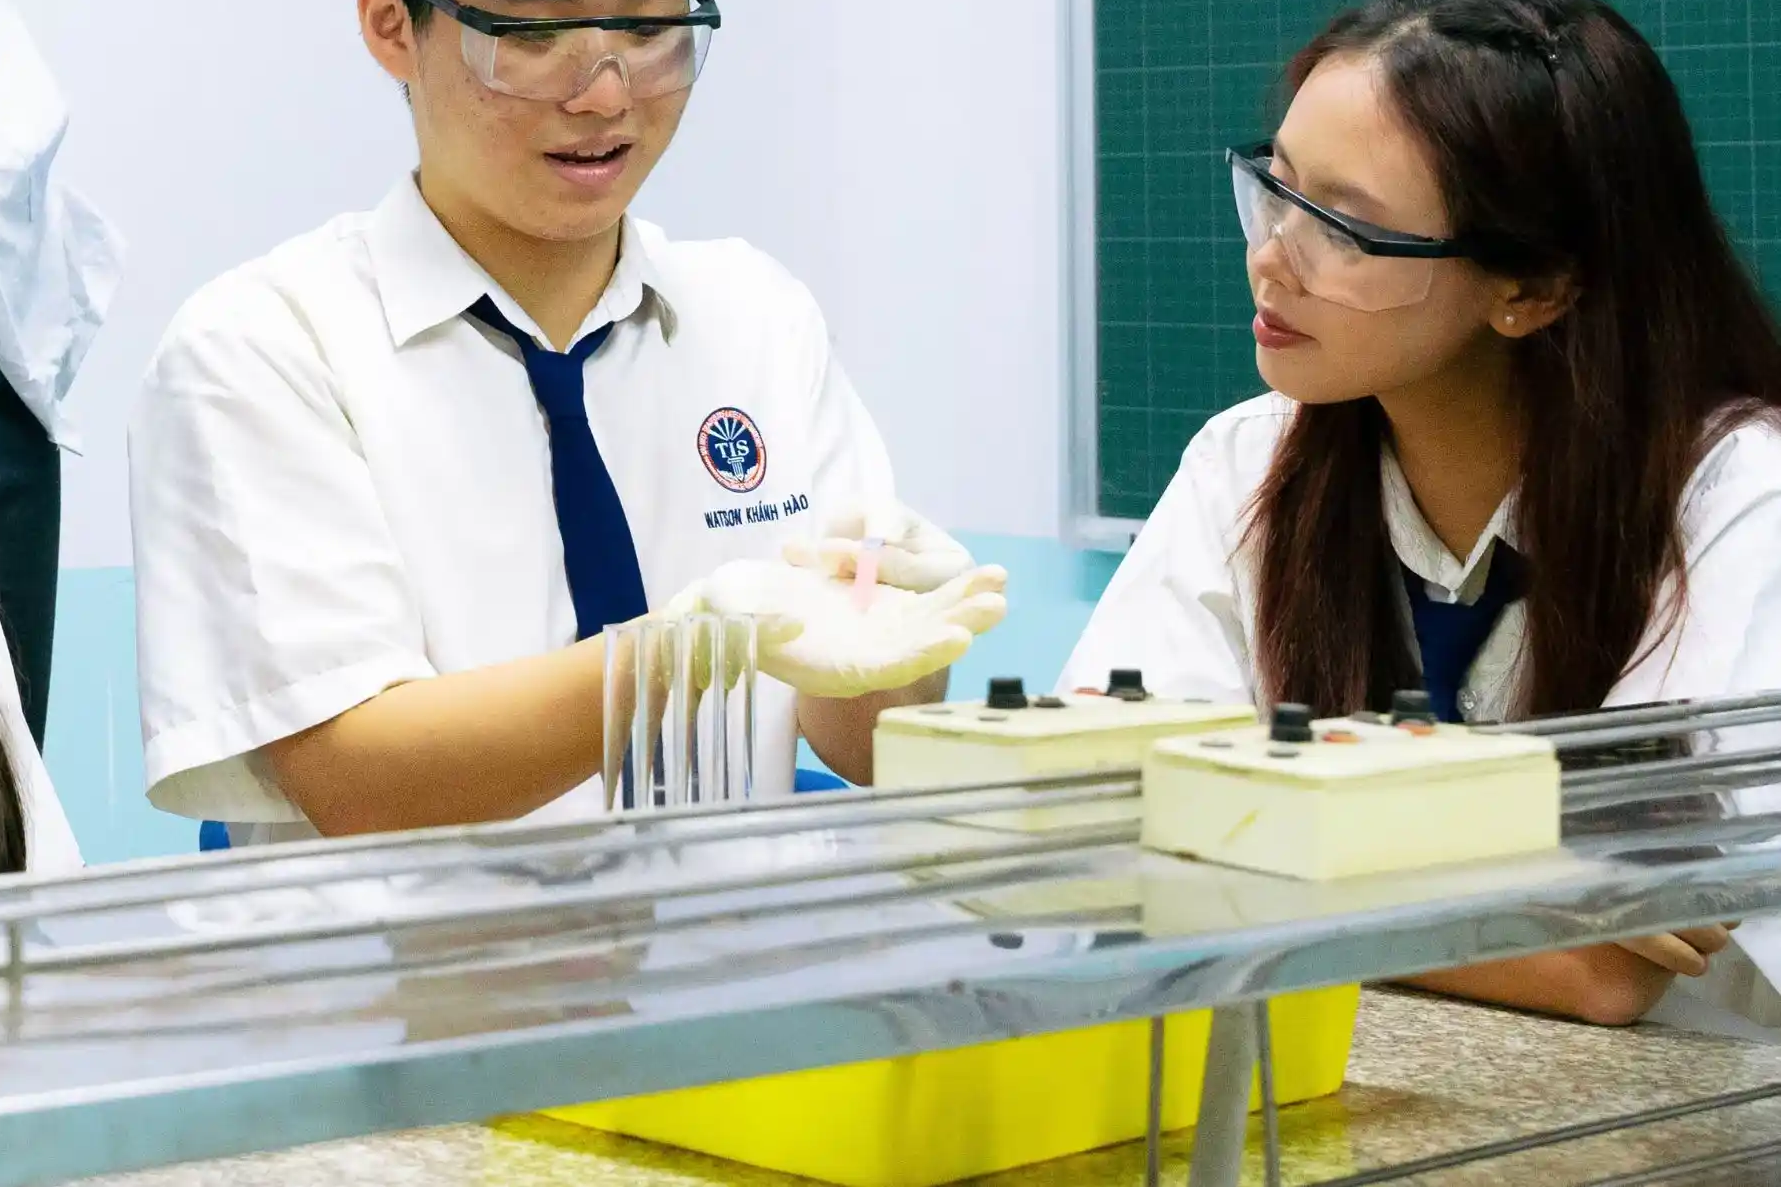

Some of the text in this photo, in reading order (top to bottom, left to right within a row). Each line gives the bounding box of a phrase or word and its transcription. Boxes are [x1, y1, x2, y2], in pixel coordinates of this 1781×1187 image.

[715, 439, 750, 459] TIS
[704, 494, 809, 528] WATSON KHÁNH HÀO
